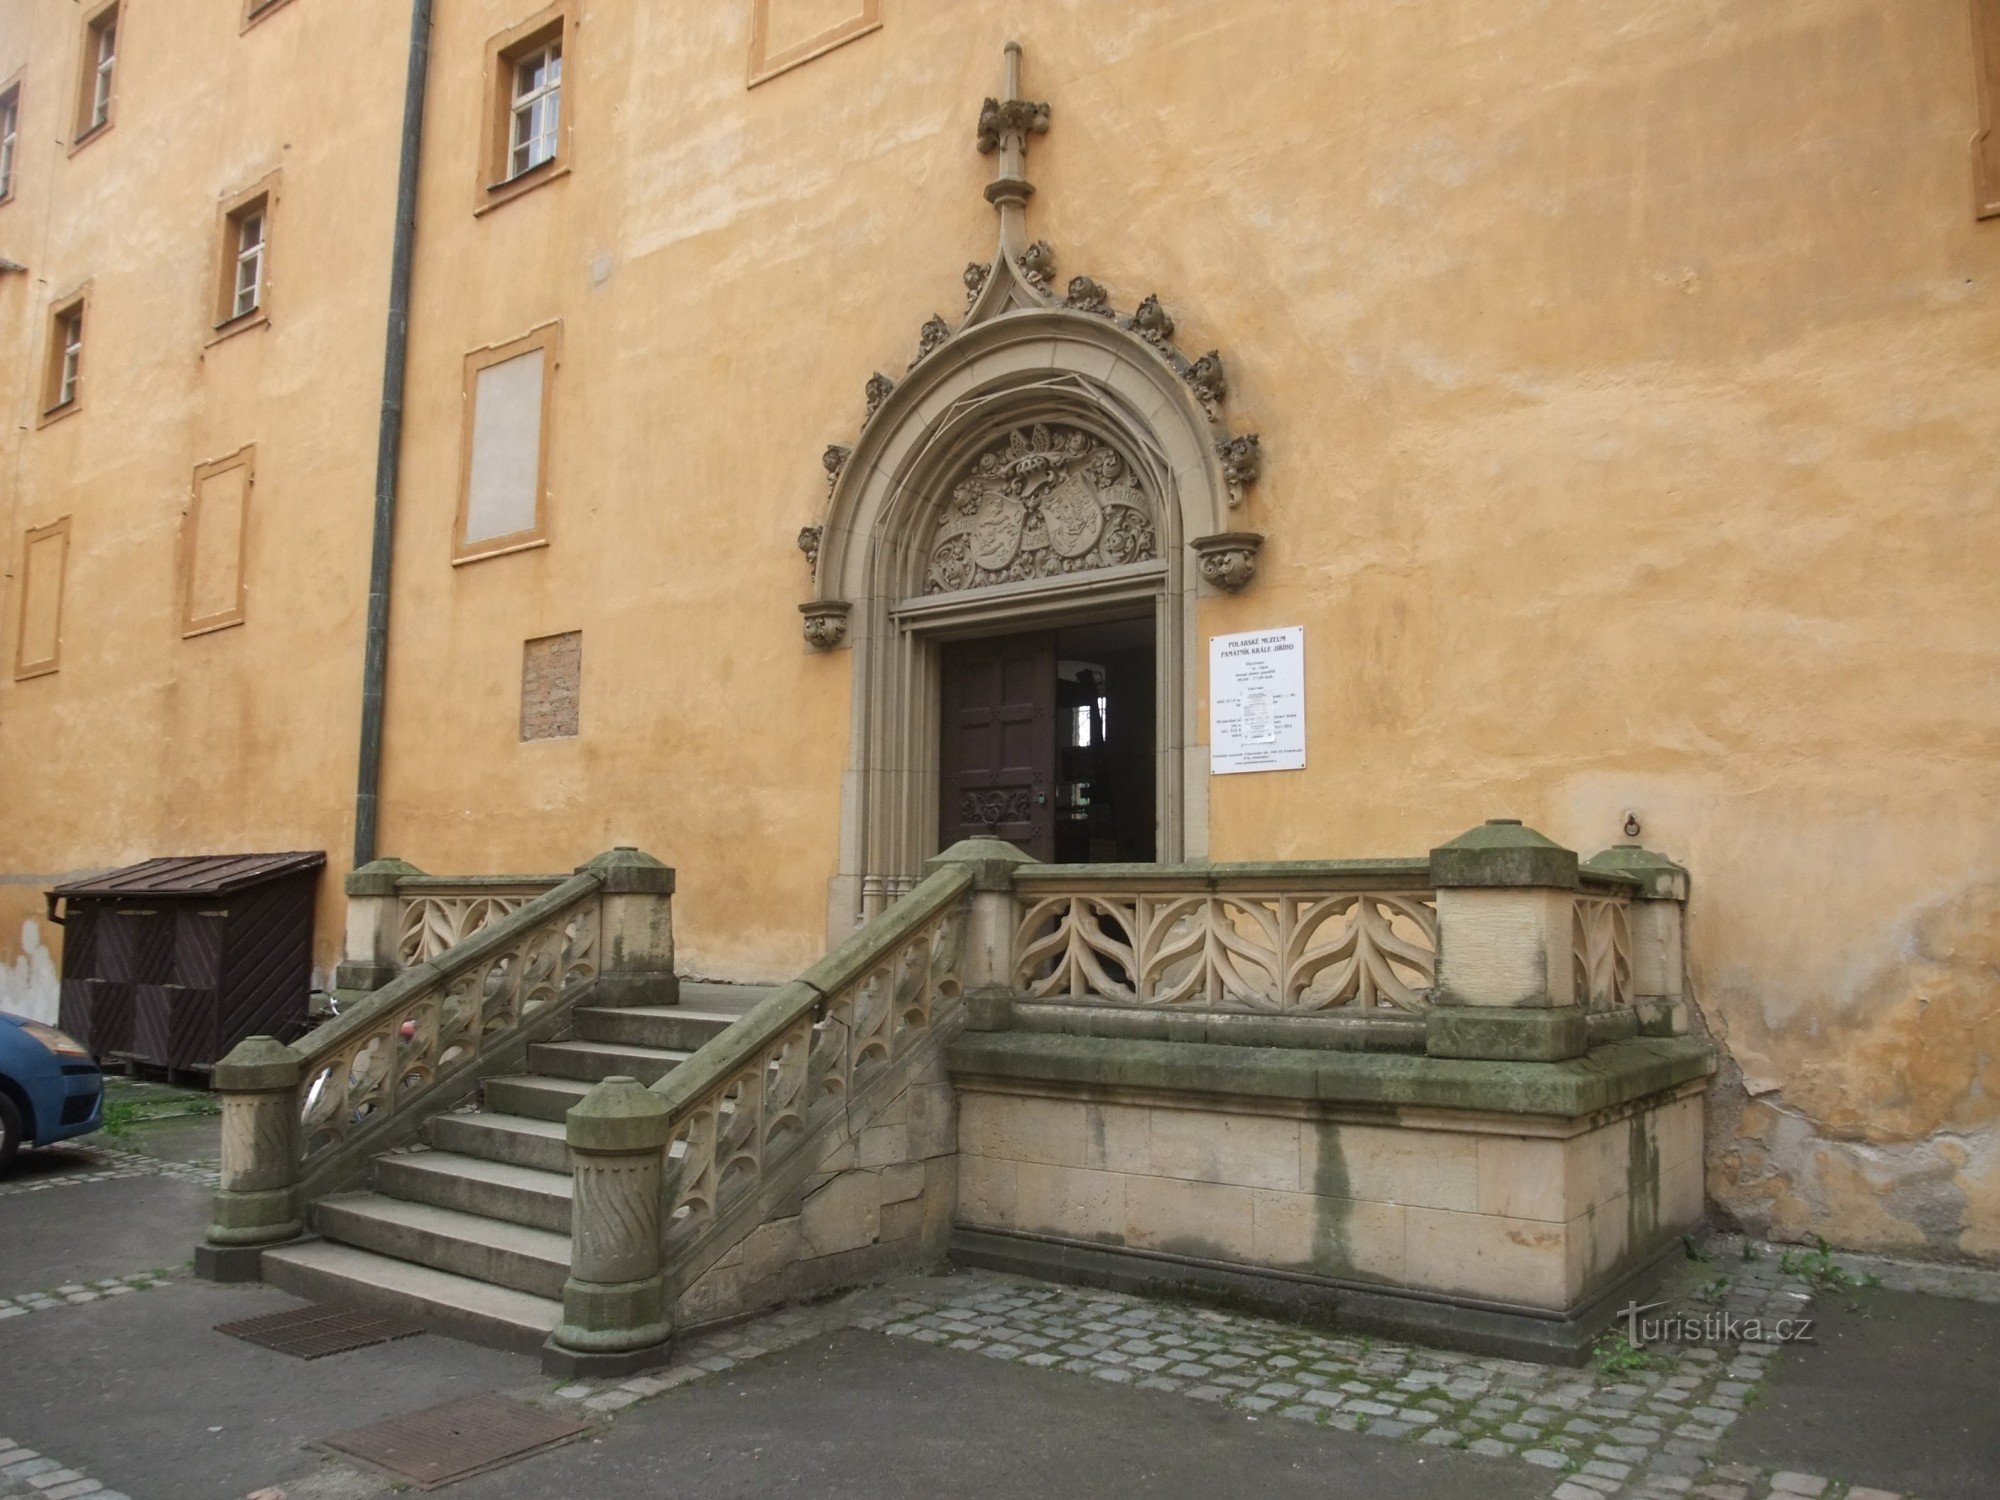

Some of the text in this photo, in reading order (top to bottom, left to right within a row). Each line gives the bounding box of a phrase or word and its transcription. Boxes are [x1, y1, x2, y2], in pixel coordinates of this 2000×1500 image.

[1228, 635, 1286, 648] POLABSKÉ MUZEUM
[1251, 645, 1271, 655] KRÁLE
